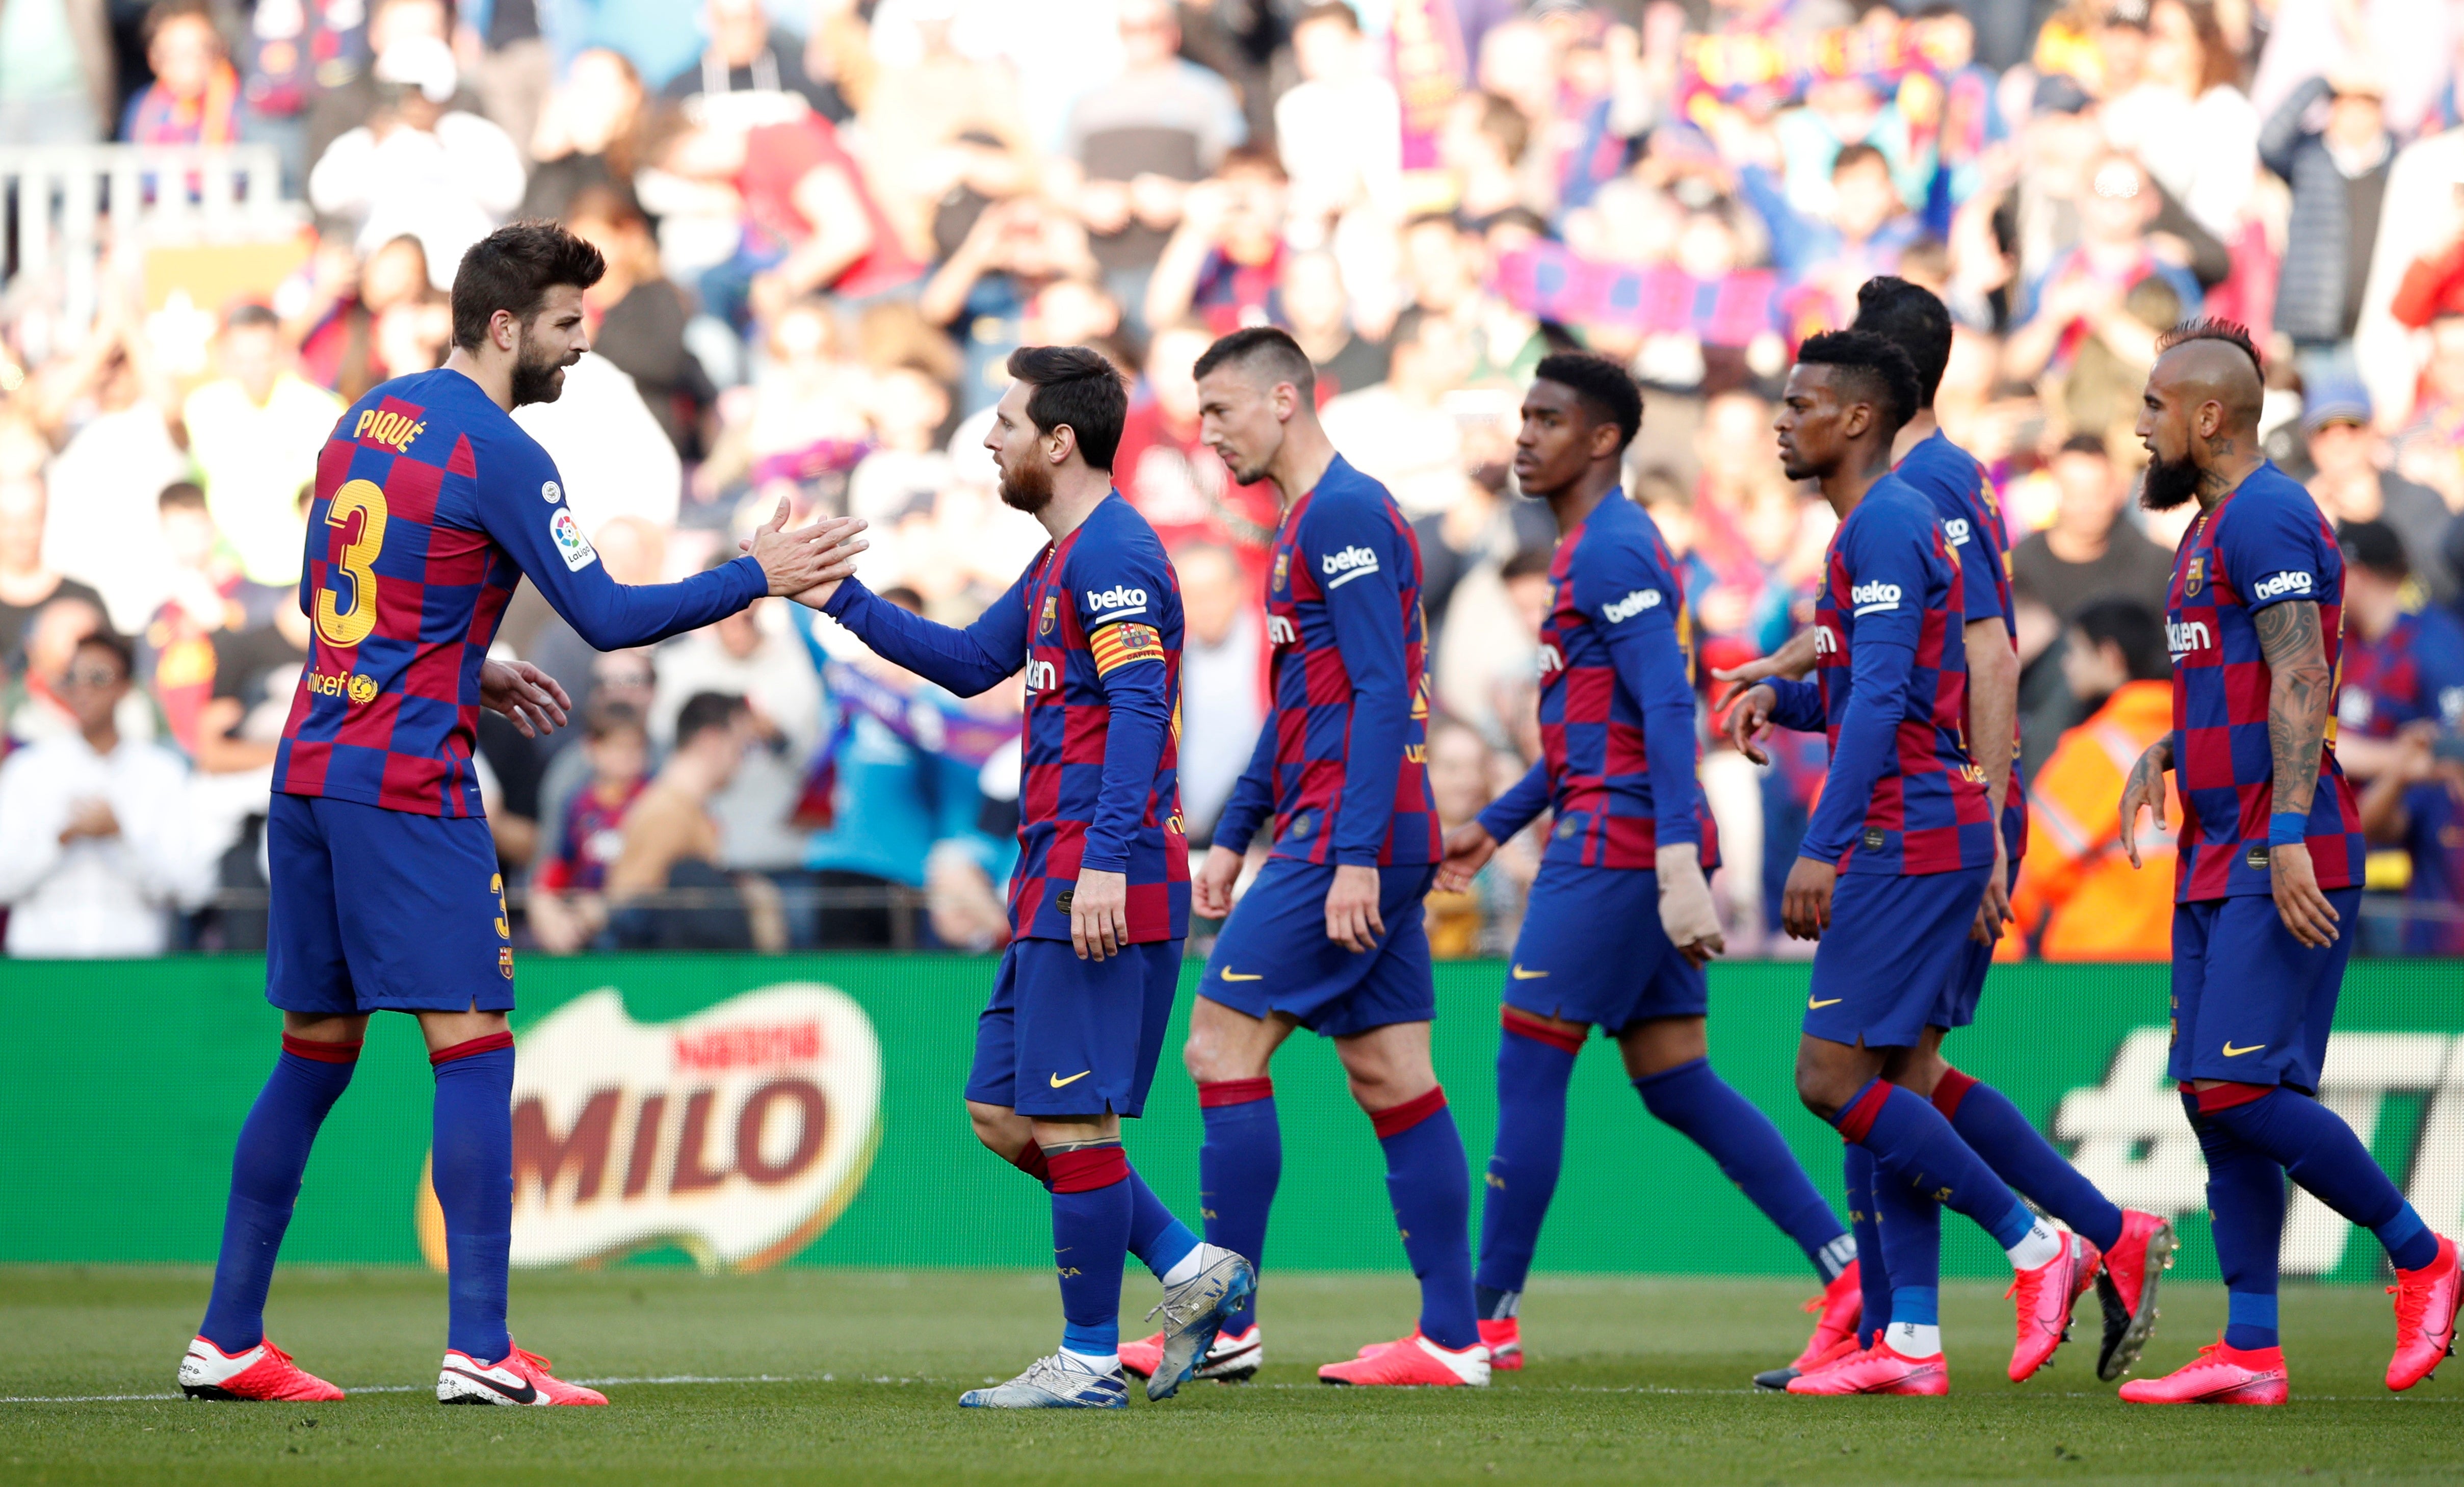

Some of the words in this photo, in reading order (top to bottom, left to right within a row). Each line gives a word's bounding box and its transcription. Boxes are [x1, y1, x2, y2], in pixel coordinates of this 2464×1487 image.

[353, 409, 427, 453] PIQUÉ
[313, 479, 388, 648] 3
[567, 545, 590, 563] LaLiga
[1322, 545, 1378, 575] beko
[1087, 585, 1147, 611] beko
[2254, 570, 2312, 601] beko
[1602, 589, 1661, 624] beko
[307, 666, 348, 697] nicef
[490, 872, 509, 939] 3
[511, 1077, 829, 1209] MILO
